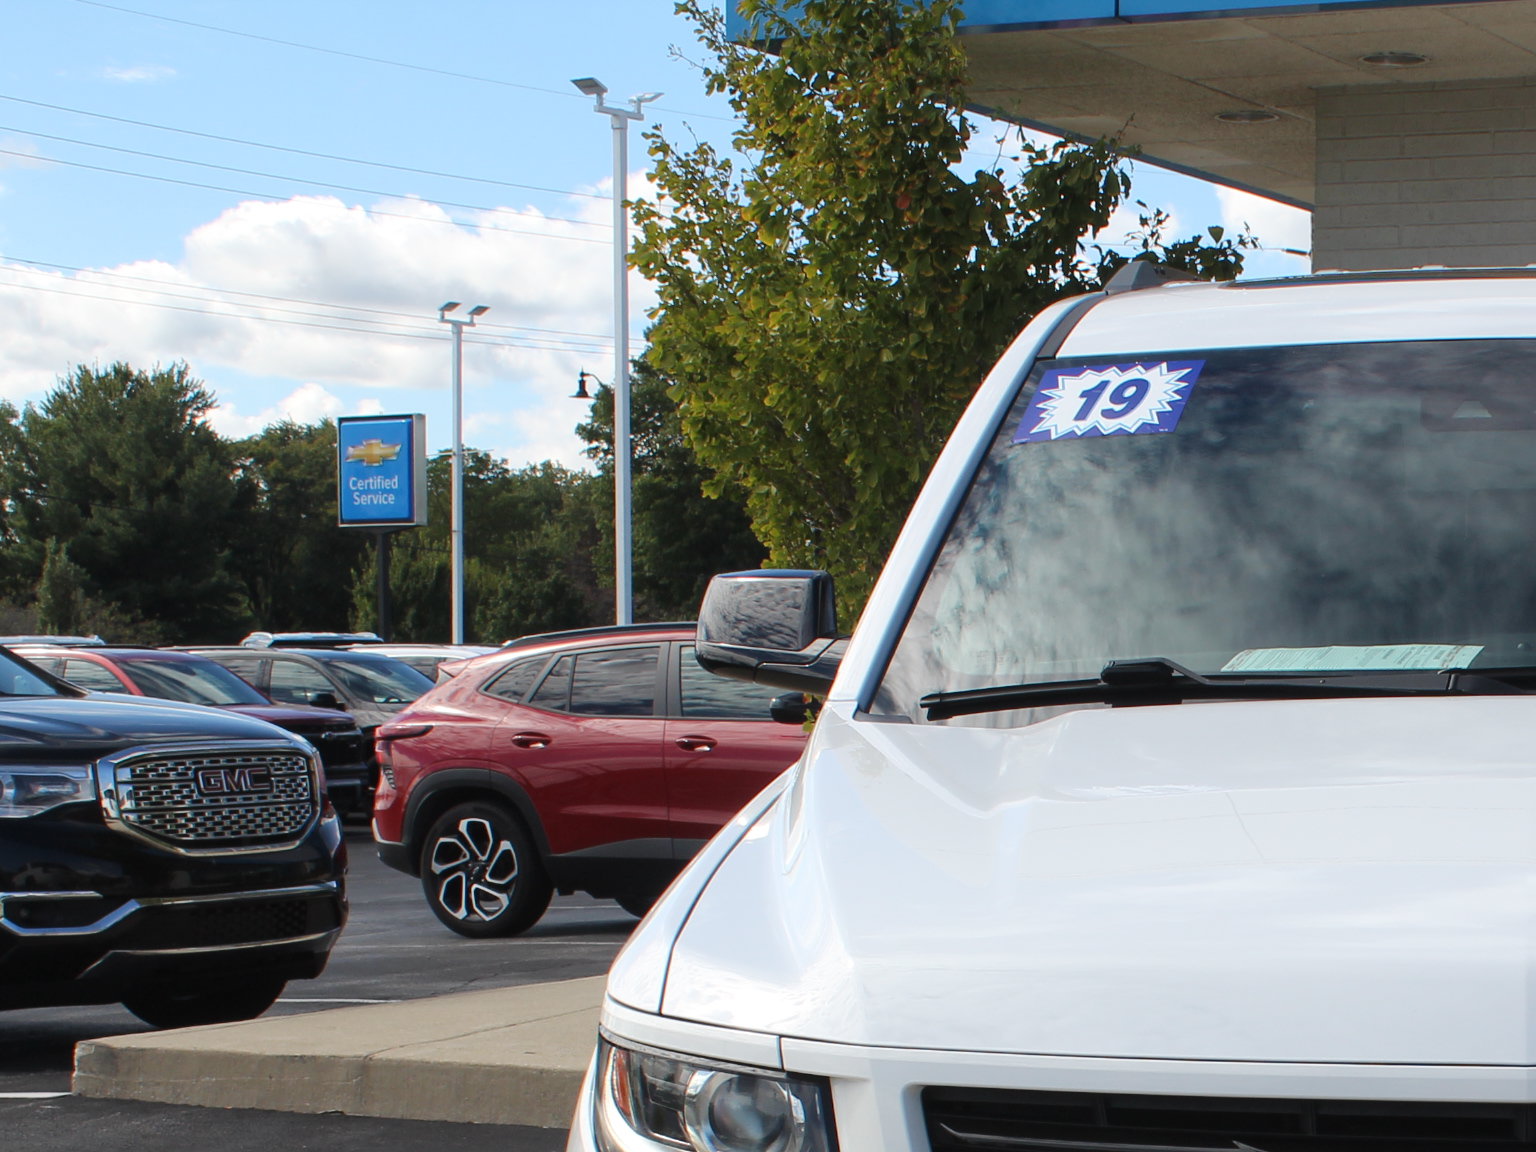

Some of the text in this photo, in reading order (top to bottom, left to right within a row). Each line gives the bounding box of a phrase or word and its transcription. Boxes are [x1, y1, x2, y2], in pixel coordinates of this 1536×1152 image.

[1072, 378, 1151, 421] 19
[349, 475, 399, 490] Certified
[353, 491, 396, 505] Service
[198, 767, 271, 793] GMC
